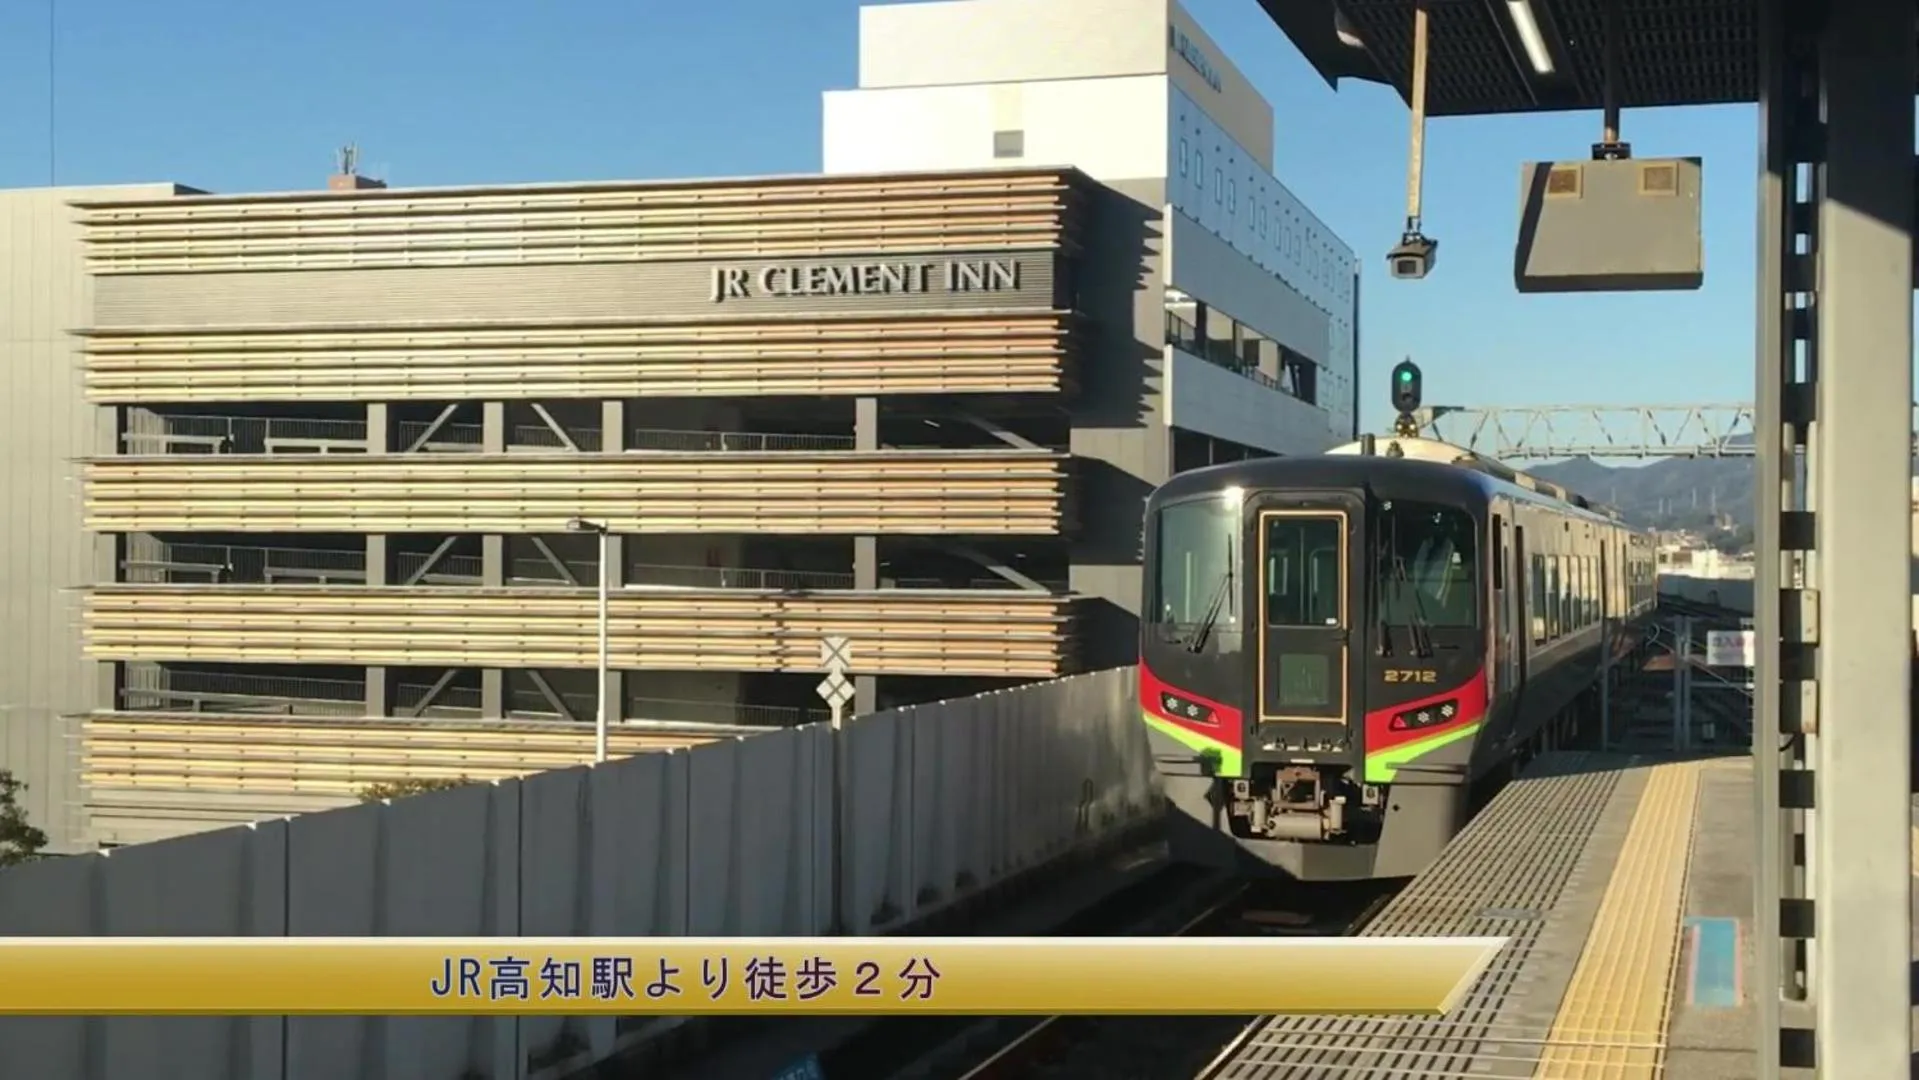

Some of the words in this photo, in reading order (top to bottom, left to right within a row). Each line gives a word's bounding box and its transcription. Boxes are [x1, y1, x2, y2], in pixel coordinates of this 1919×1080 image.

[709, 264, 750, 303] JR
[758, 263, 934, 297] CLEMENT
[945, 258, 1021, 292] INN
[1384, 669, 1437, 682] 2712
